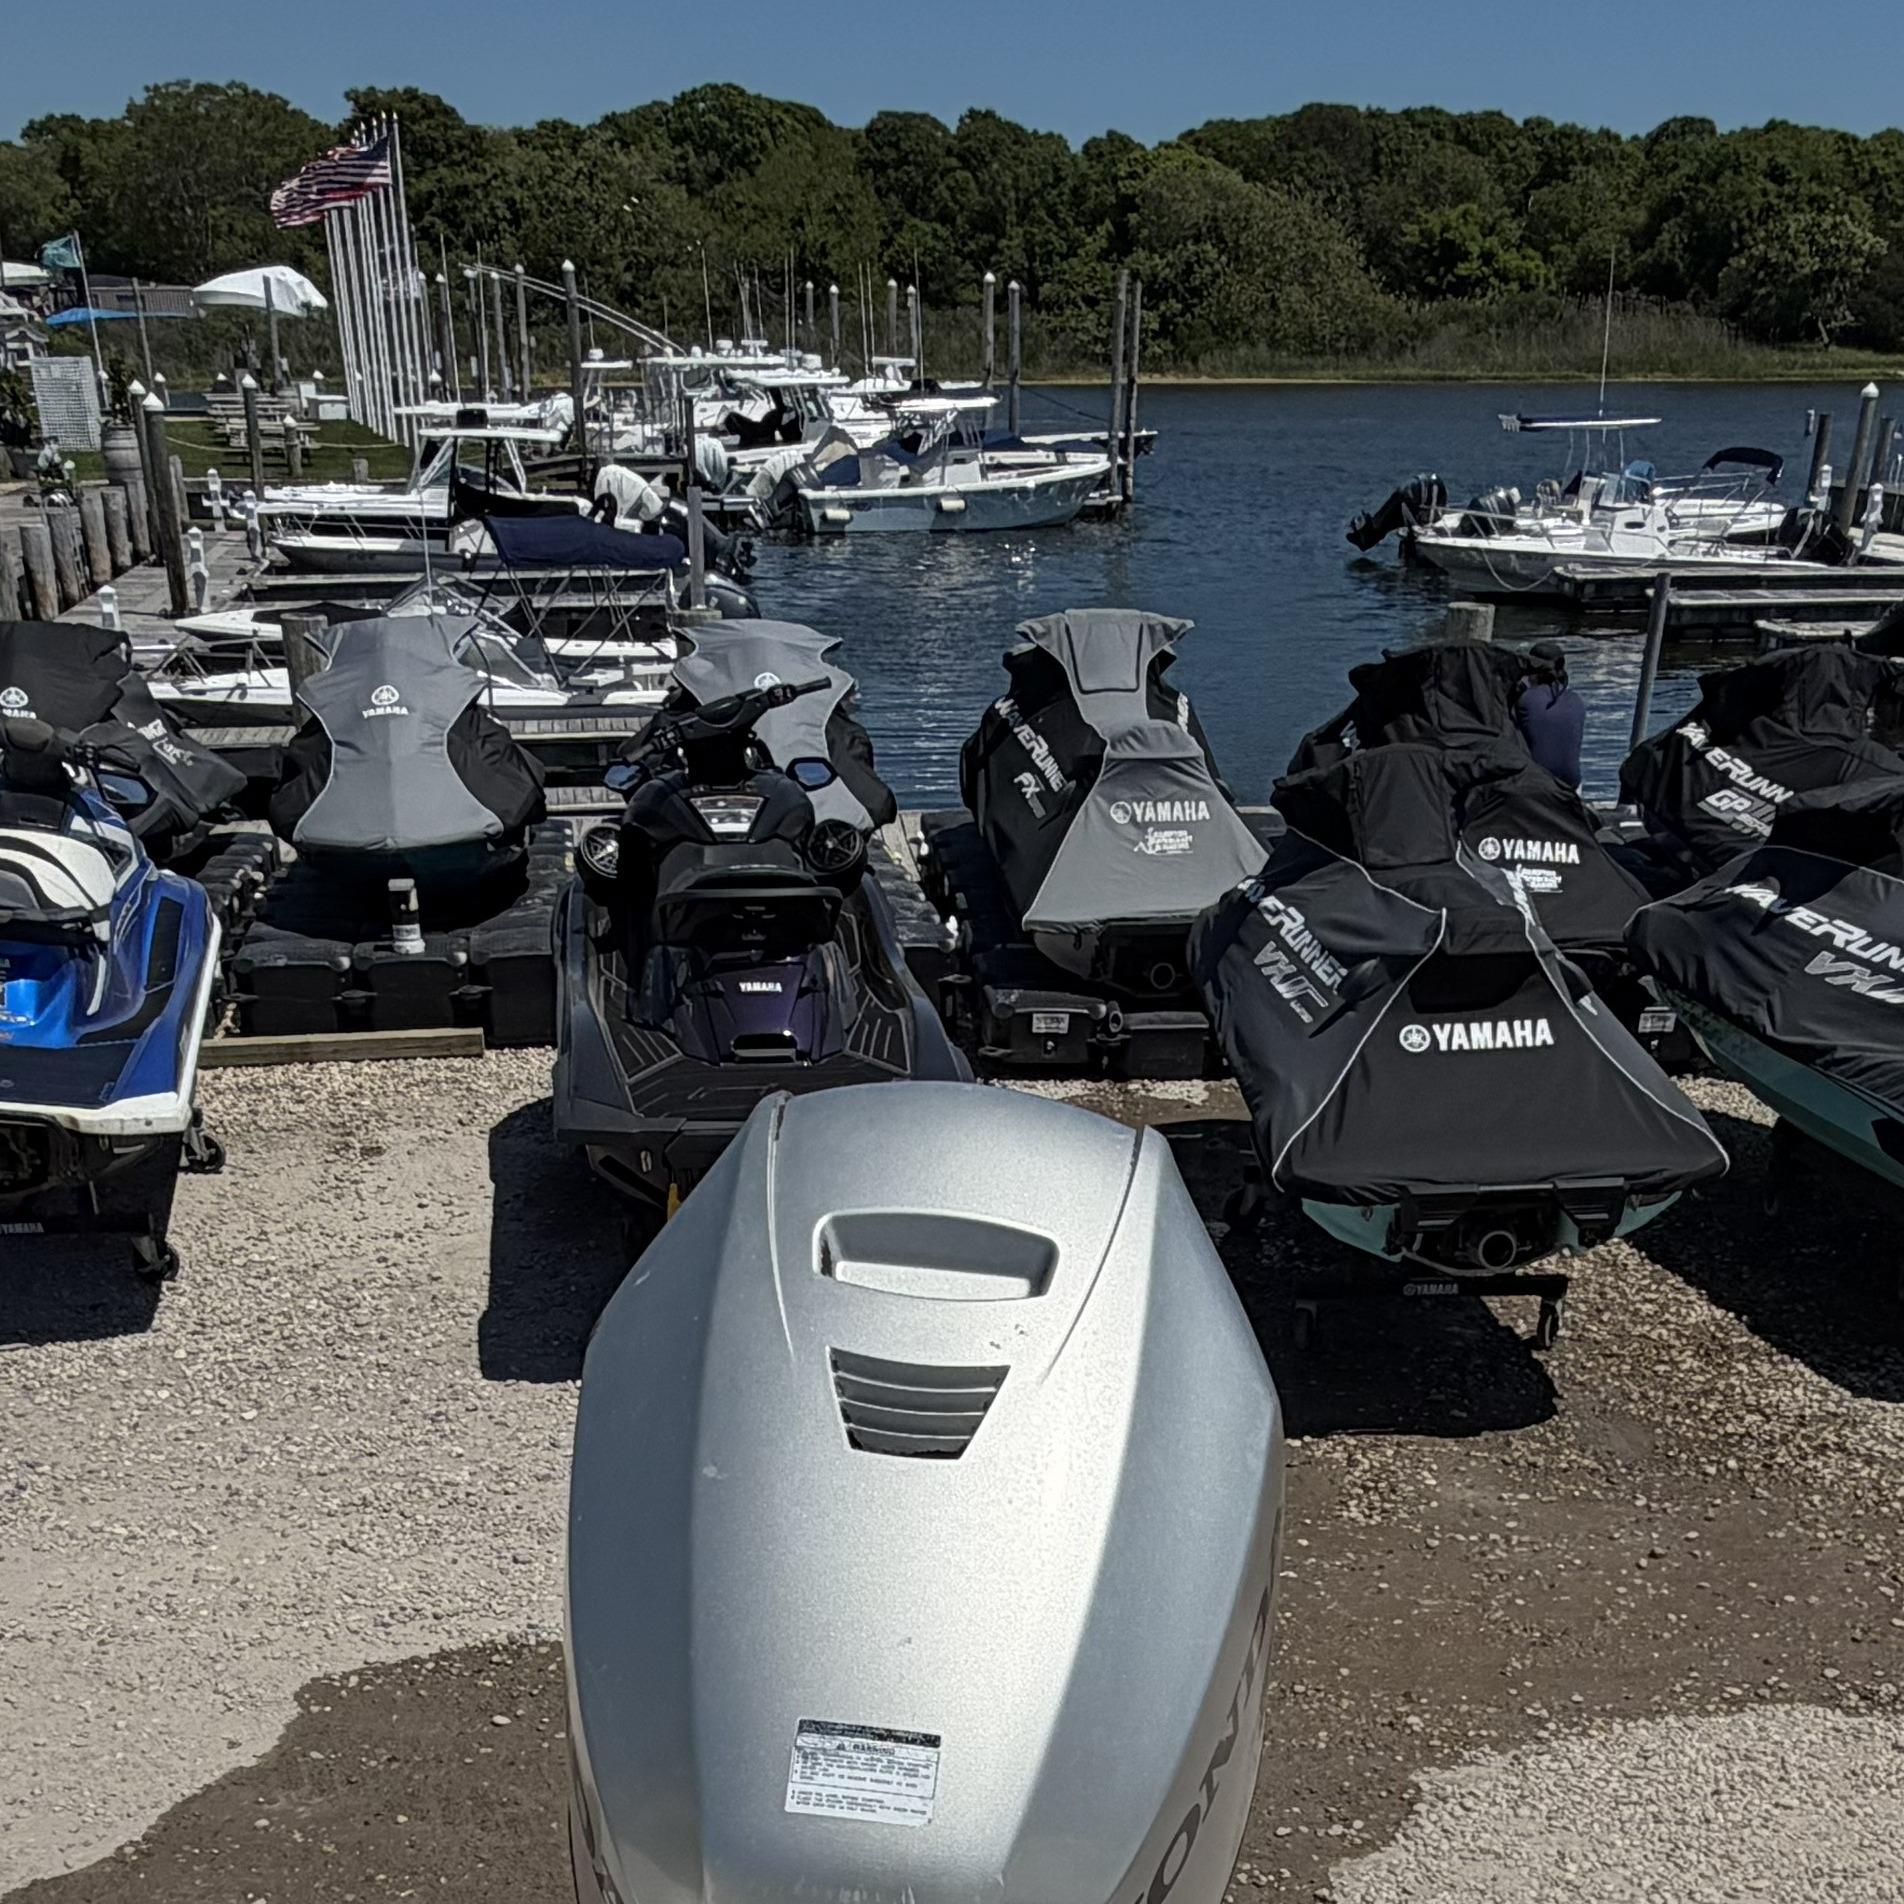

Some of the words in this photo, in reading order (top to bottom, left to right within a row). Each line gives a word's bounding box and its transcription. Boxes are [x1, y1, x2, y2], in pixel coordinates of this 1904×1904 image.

[362, 706, 409, 719] YAMAHA
[1132, 800, 1212, 823] YAMAHA
[1502, 838, 1581, 865] YAMAHA
[738, 981, 783, 993] YAMAHA
[1432, 1018, 1555, 1052] YAMAHA
